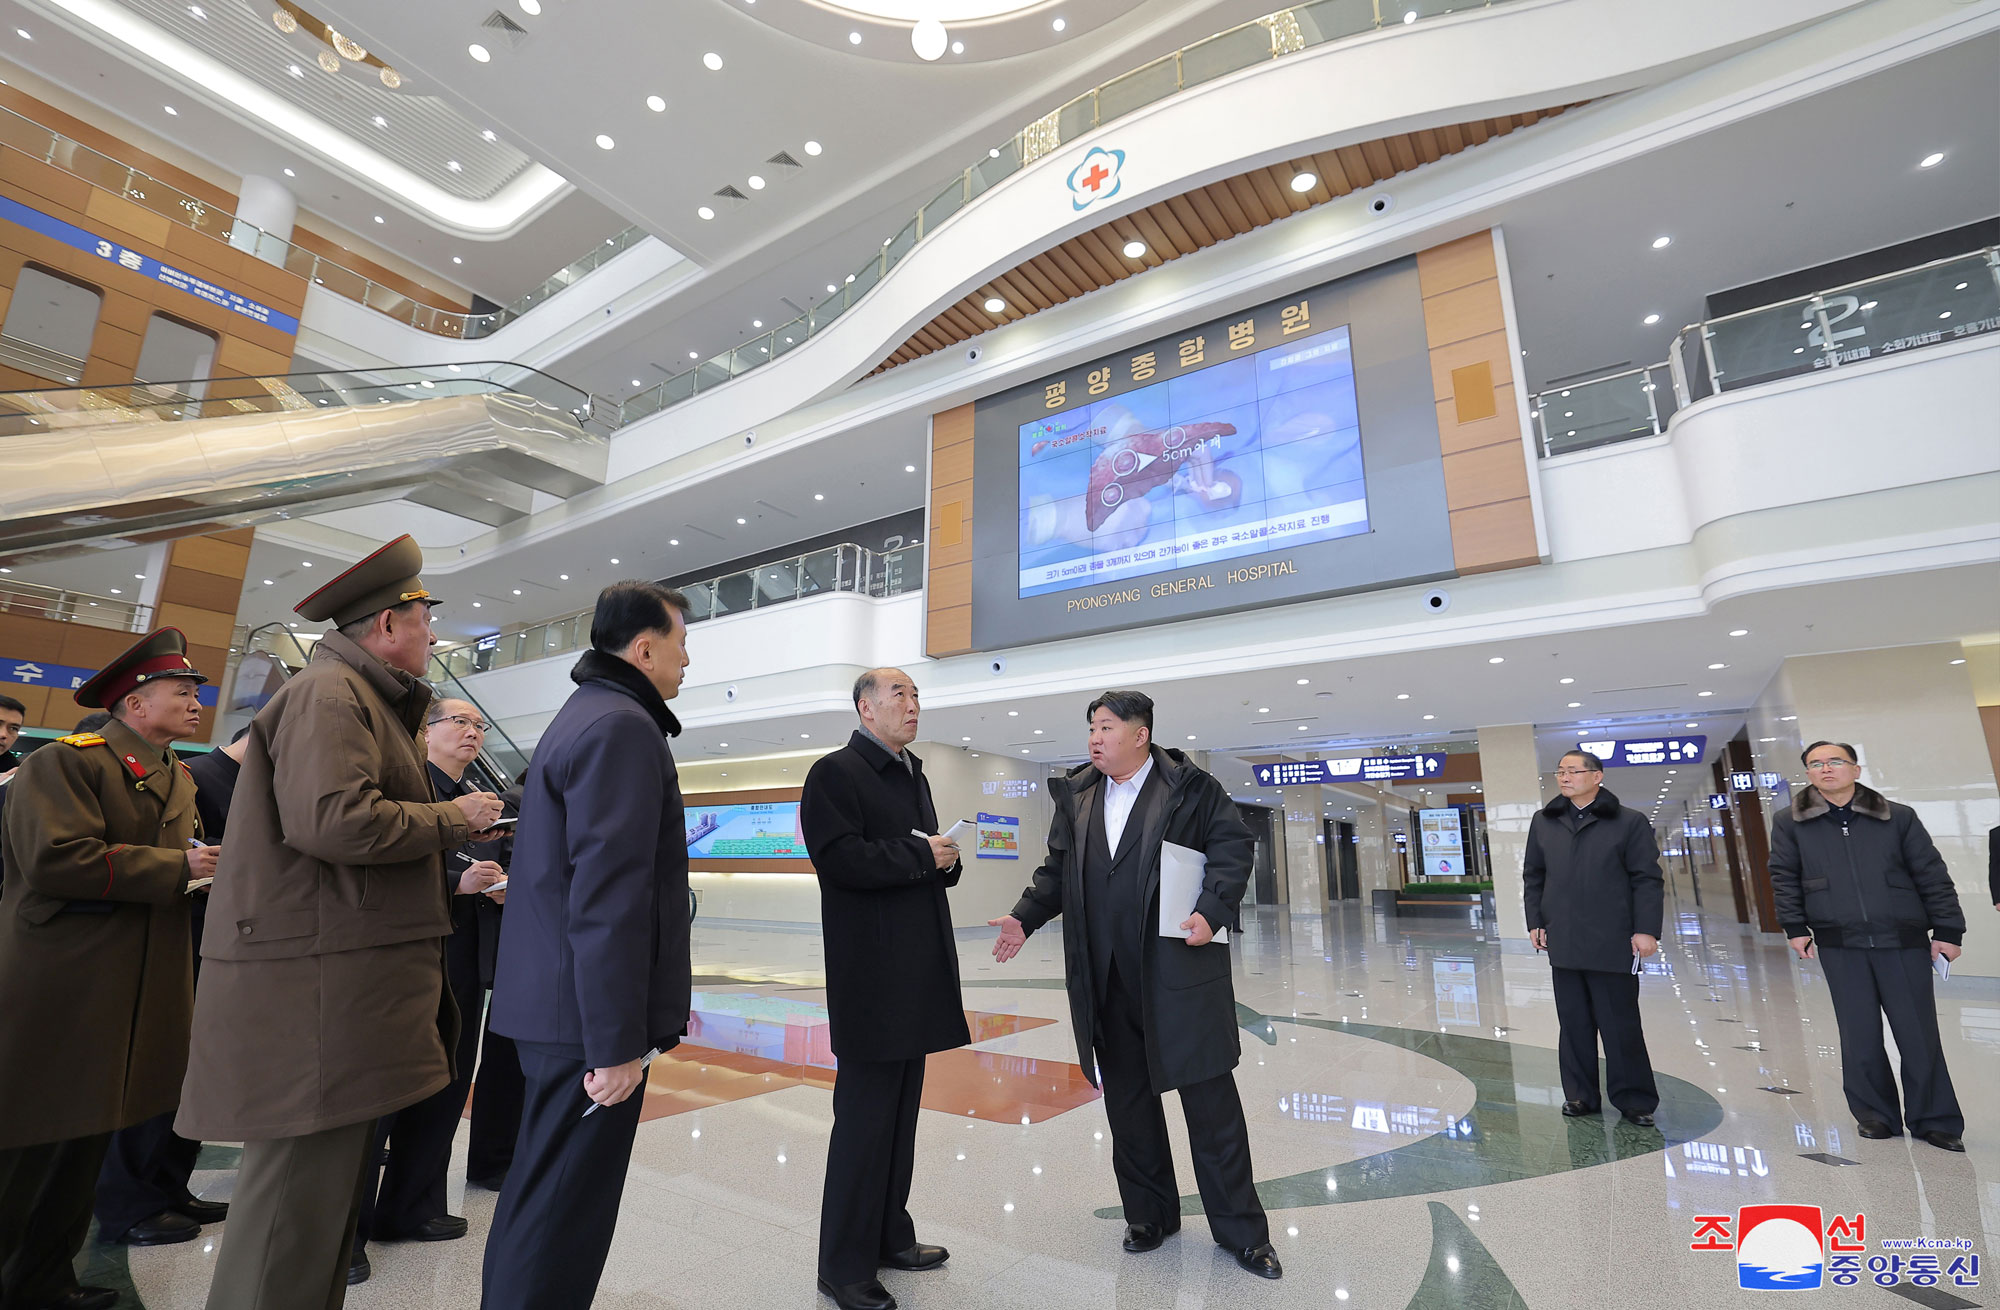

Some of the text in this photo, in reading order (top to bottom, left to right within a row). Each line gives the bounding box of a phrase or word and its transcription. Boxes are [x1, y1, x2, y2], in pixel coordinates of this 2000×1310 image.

[1046, 569, 1060, 580] 크기
[1133, 550, 1156, 562] 있으며
[1211, 535, 1228, 546] 경우
[1311, 513, 1330, 526] 진행
[1067, 560, 1298, 613] PYONGYANG GENERAL HOSPITAL
